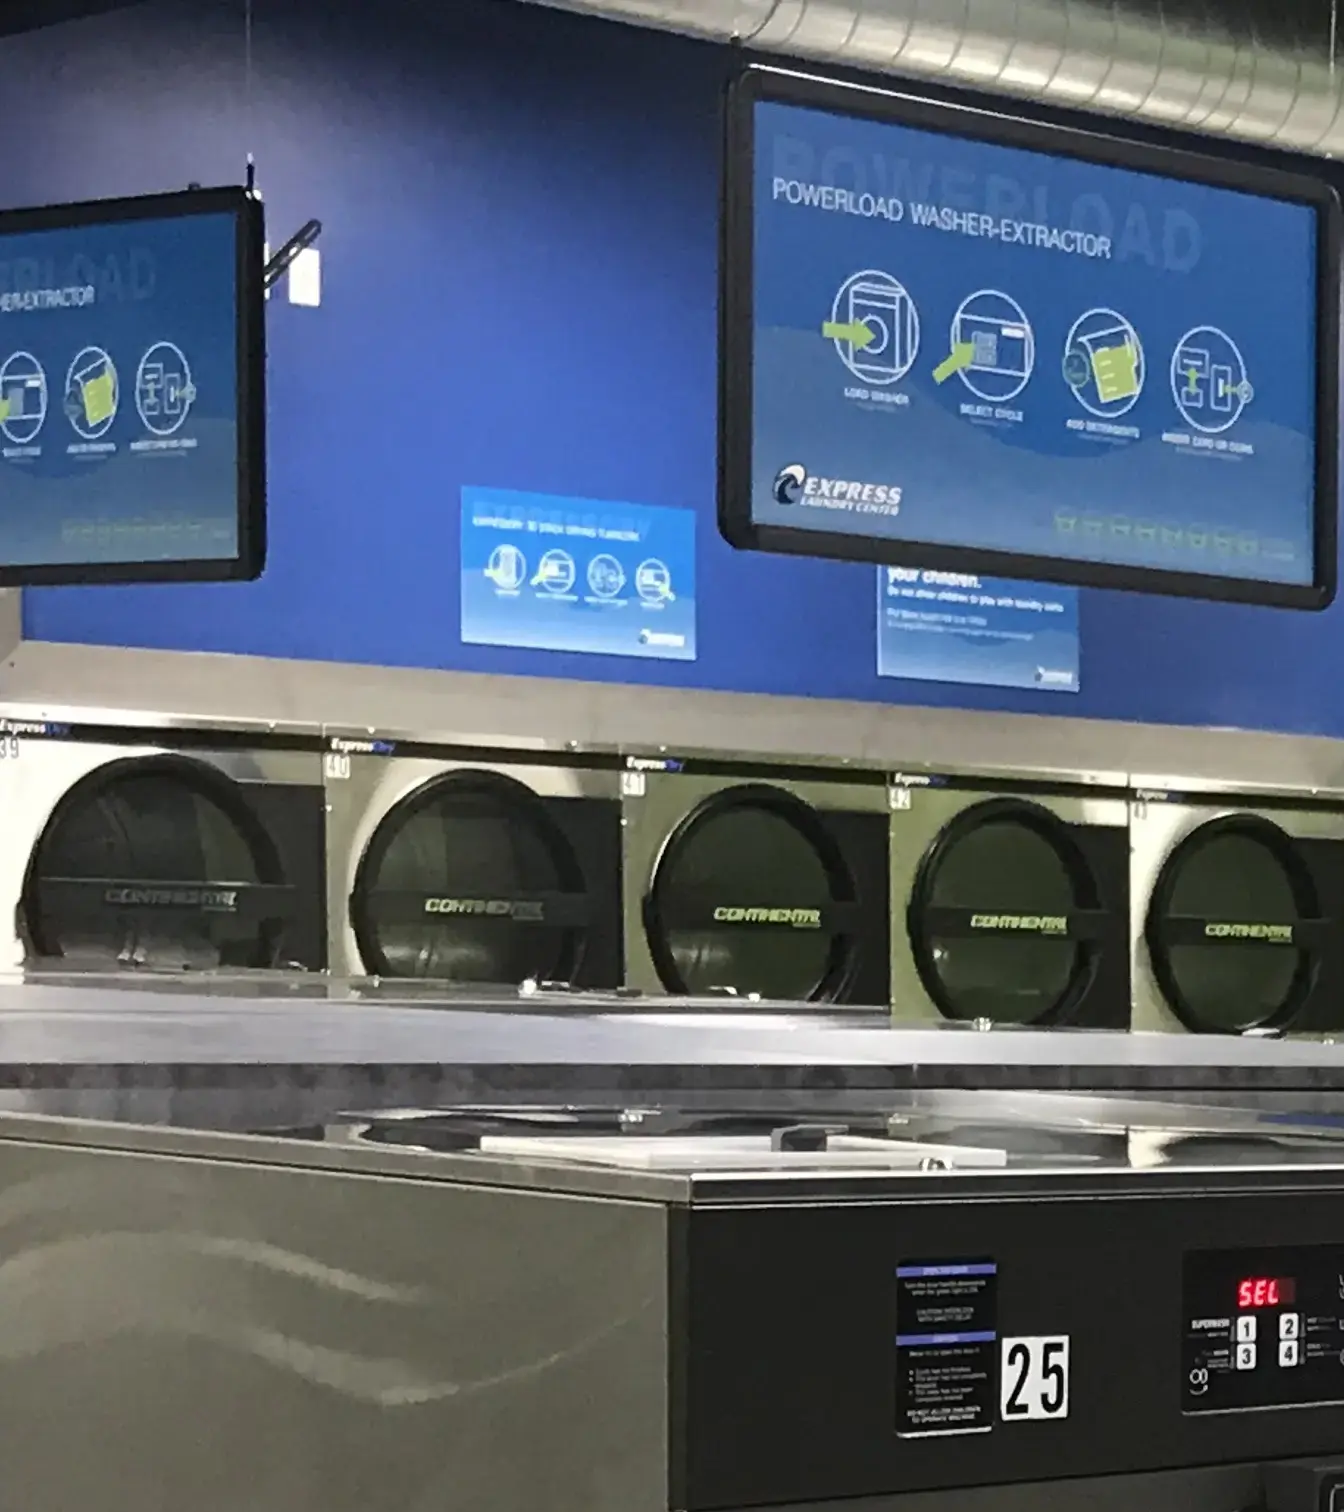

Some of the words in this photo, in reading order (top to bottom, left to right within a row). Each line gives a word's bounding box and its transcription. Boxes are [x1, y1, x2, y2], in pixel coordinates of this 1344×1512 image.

[772, 177, 904, 223] POWERLOAD
[910, 201, 1112, 260] WASHER-EXTRACTOR
[803, 475, 903, 506] EXPRESS
[800, 495, 853, 512] LAUNDRY
[855, 502, 900, 517] CENTER
[1238, 1277, 1279, 1307] SEL
[1284, 1317, 1294, 1335] 2
[1242, 1347, 1252, 1365] 3
[1283, 1344, 1293, 1362] 4
[1006, 1342, 1065, 1415] 25
